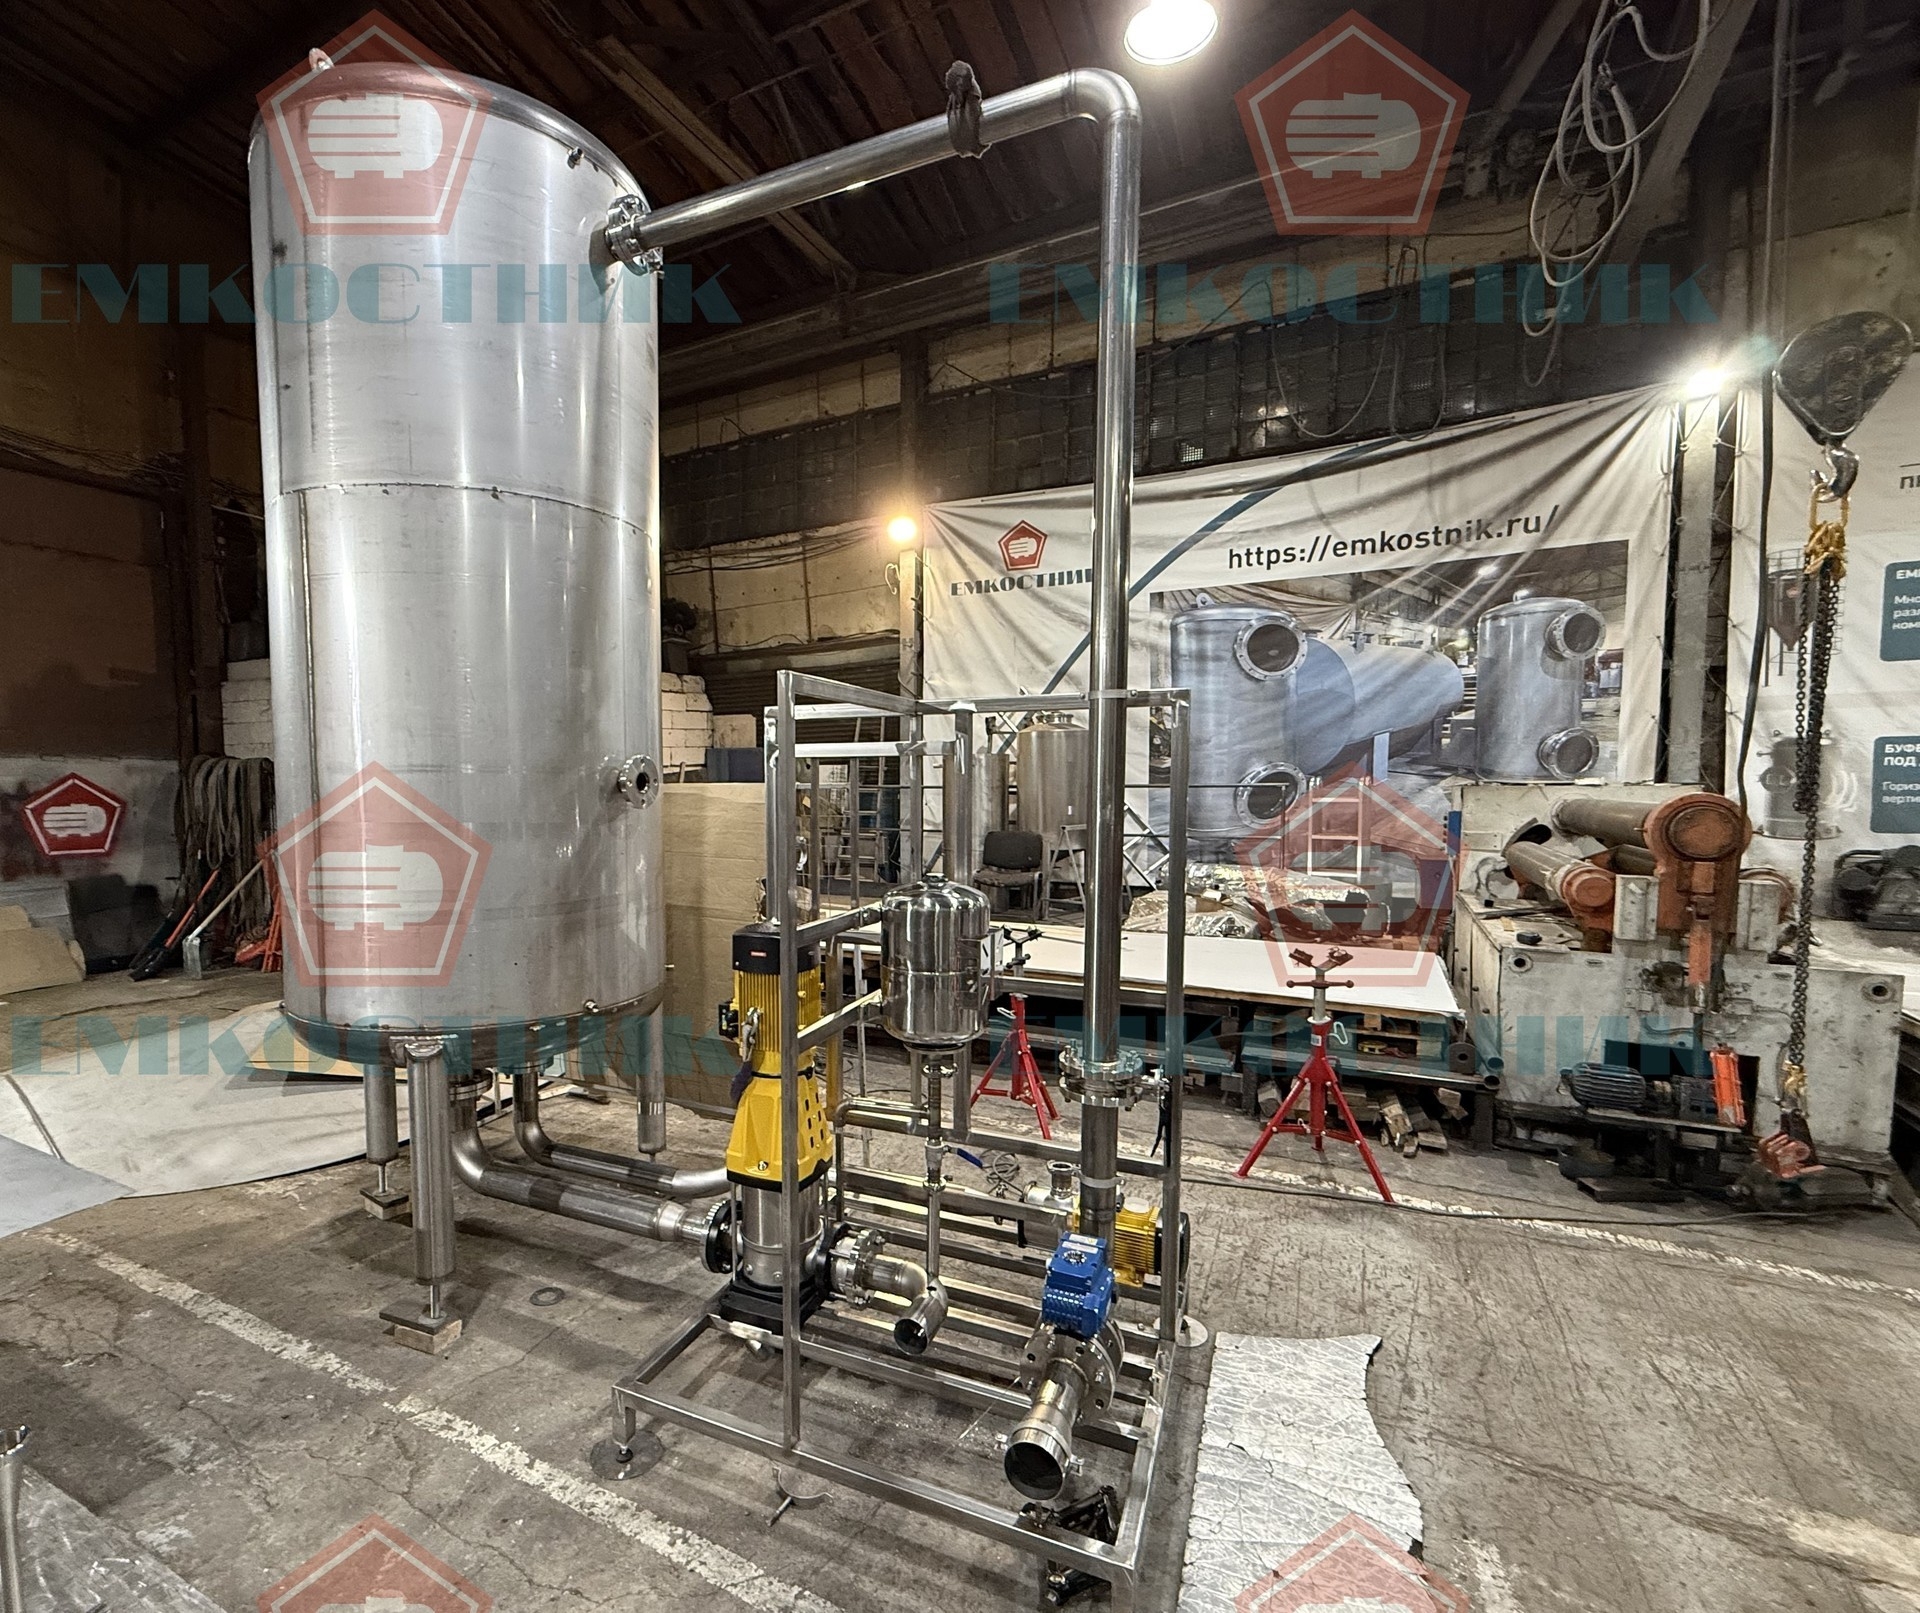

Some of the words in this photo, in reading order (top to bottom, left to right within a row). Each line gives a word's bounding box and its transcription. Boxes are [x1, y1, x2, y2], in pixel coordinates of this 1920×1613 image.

[1228, 504, 1560, 570] https://emkostnik.ru/
[1896, 568, 1920, 580] ЕМ
[1883, 756, 1917, 767] ПОД
